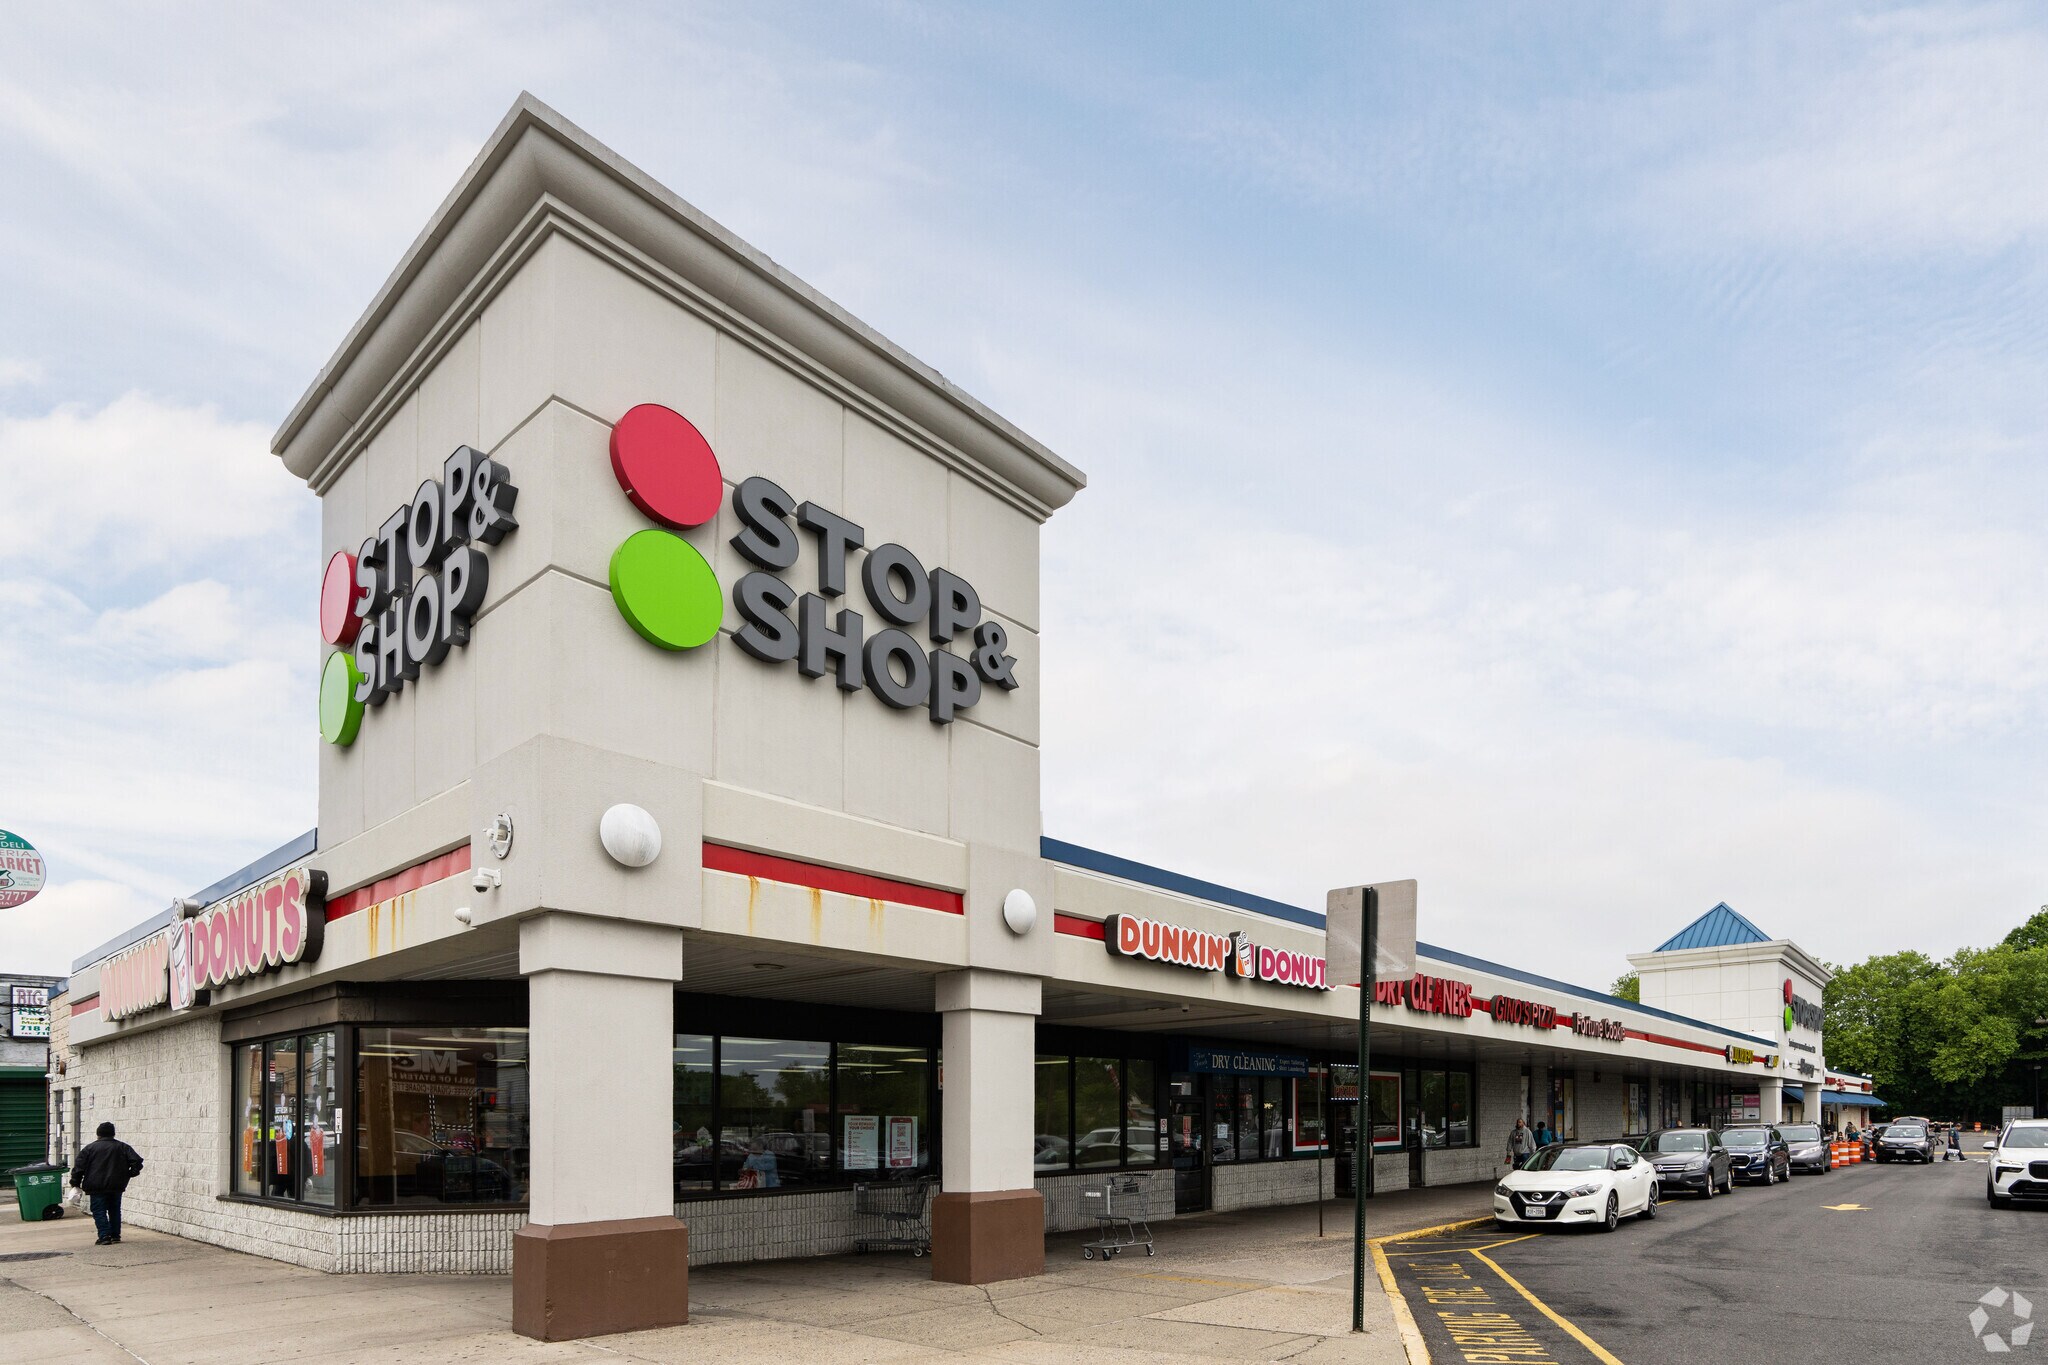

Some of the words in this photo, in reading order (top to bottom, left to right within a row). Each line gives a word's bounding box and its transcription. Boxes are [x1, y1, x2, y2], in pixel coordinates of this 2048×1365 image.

[355, 445, 482, 617] STOP
[468, 459, 518, 545] &
[730, 476, 981, 644] STOP
[971, 621, 1018, 691] &
[355, 544, 488, 704] SHOP
[730, 571, 981, 725] SHOP
[1, 841, 25, 849] DELI
[101, 934, 169, 1021] DUNKIN'
[193, 875, 301, 985] DONUTS
[1119, 915, 1231, 970] DUNKIN'
[1261, 947, 1336, 989] DONUT
[1376, 981, 1404, 1006] DRY
[1410, 973, 1472, 1018] CLEANERS
[1495, 995, 1533, 1026] GINO'S
[1533, 1003, 1558, 1030] PIZZA
[1573, 1012, 1604, 1038] Fortune
[1603, 1017, 1626, 1042] Cookie
[1212, 1054, 1230, 1069] DRY
[1233, 1054, 1276, 1071] CLEANING
